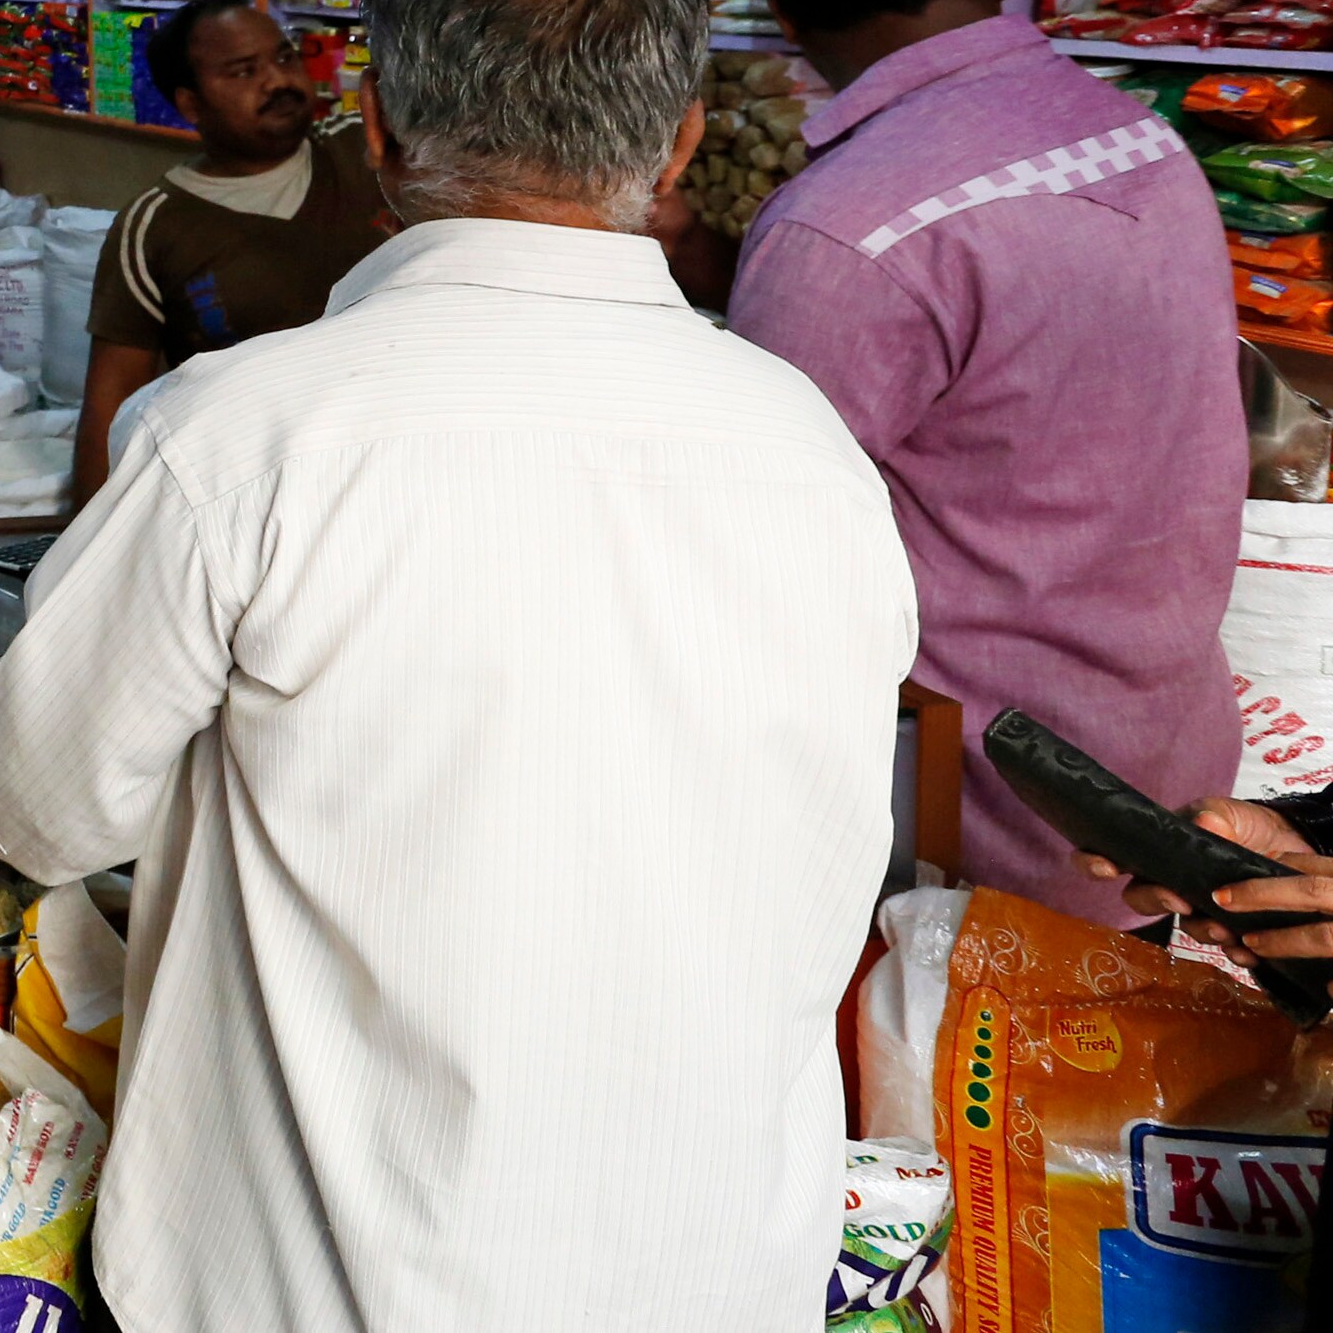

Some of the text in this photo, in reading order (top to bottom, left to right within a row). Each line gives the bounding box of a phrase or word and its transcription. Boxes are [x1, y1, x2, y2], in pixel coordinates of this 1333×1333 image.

[1058, 1019, 1097, 1037] Nutri
[1075, 1035, 1118, 1054] Fresh
[48, 1177, 66, 1210] GOLD
[968, 1143, 996, 1235] PREMIUM
[7, 1202, 26, 1232] GOLD
[843, 1221, 927, 1243] GOLD
[972, 1235, 1000, 1317] QUALITY
